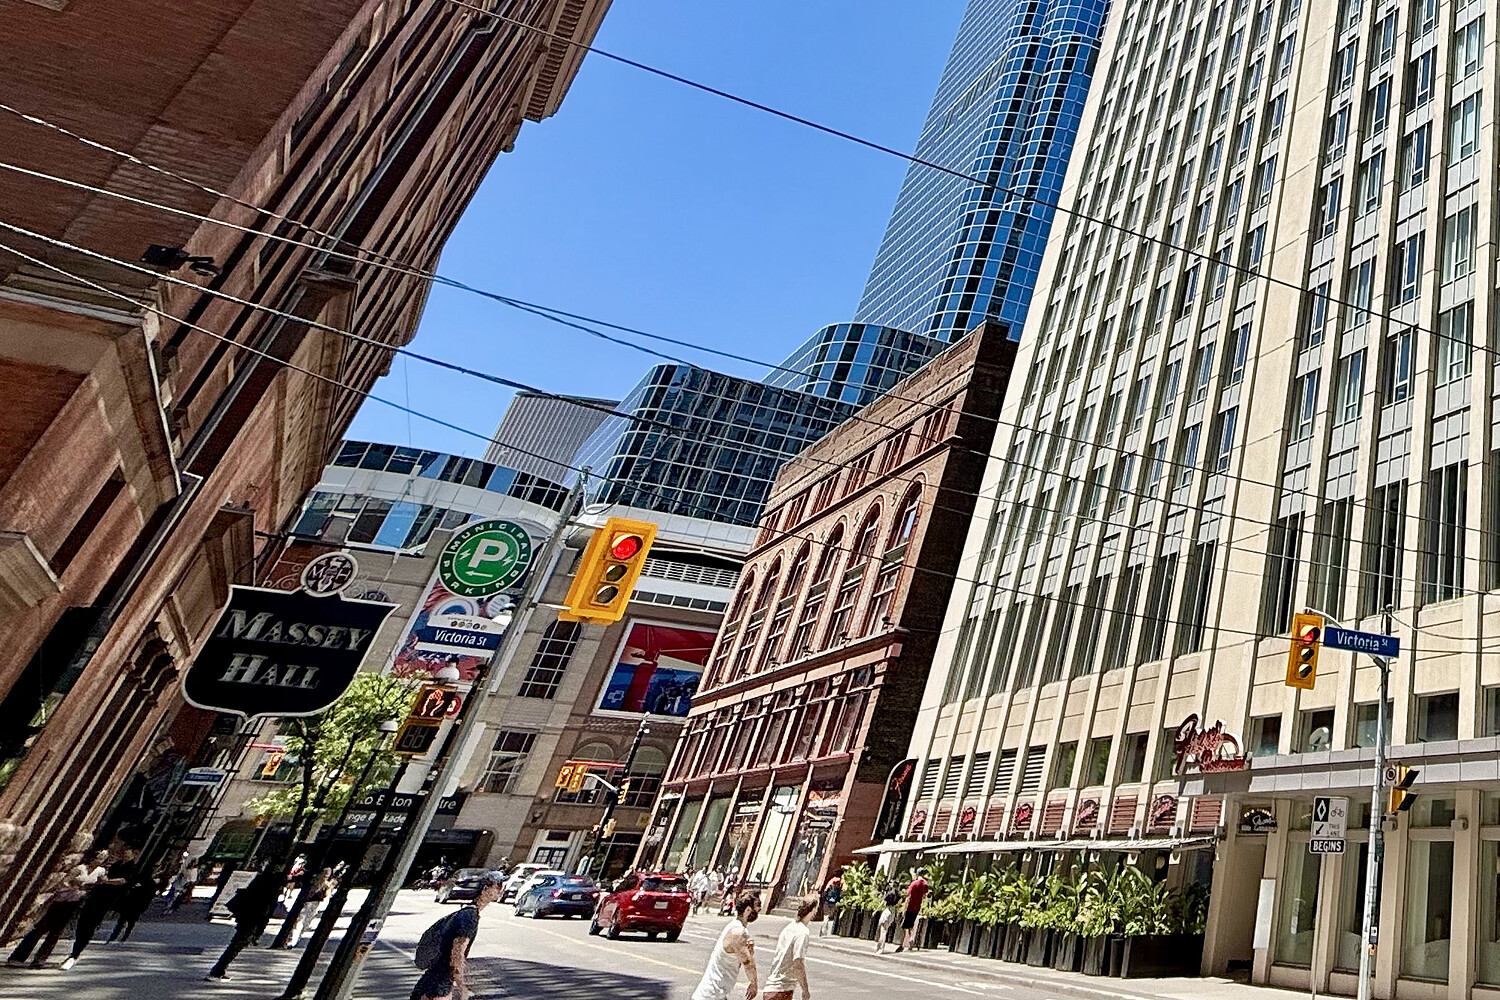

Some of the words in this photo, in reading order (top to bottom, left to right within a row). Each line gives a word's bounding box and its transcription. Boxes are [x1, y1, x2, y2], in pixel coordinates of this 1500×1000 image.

[450, 522, 528, 560] MUNICIPAL
[467, 538, 509, 568] P
[443, 559, 520, 595] PARKING
[217, 609, 371, 651] MASSEY
[434, 629, 476, 645] Victoria
[478, 637, 487, 646] St
[1336, 631, 1380, 651] Victoria
[1382, 638, 1388, 647] St
[217, 653, 320, 690] HALL
[376, 795, 412, 807] Eton
[1313, 840, 1342, 852] BEGINS
